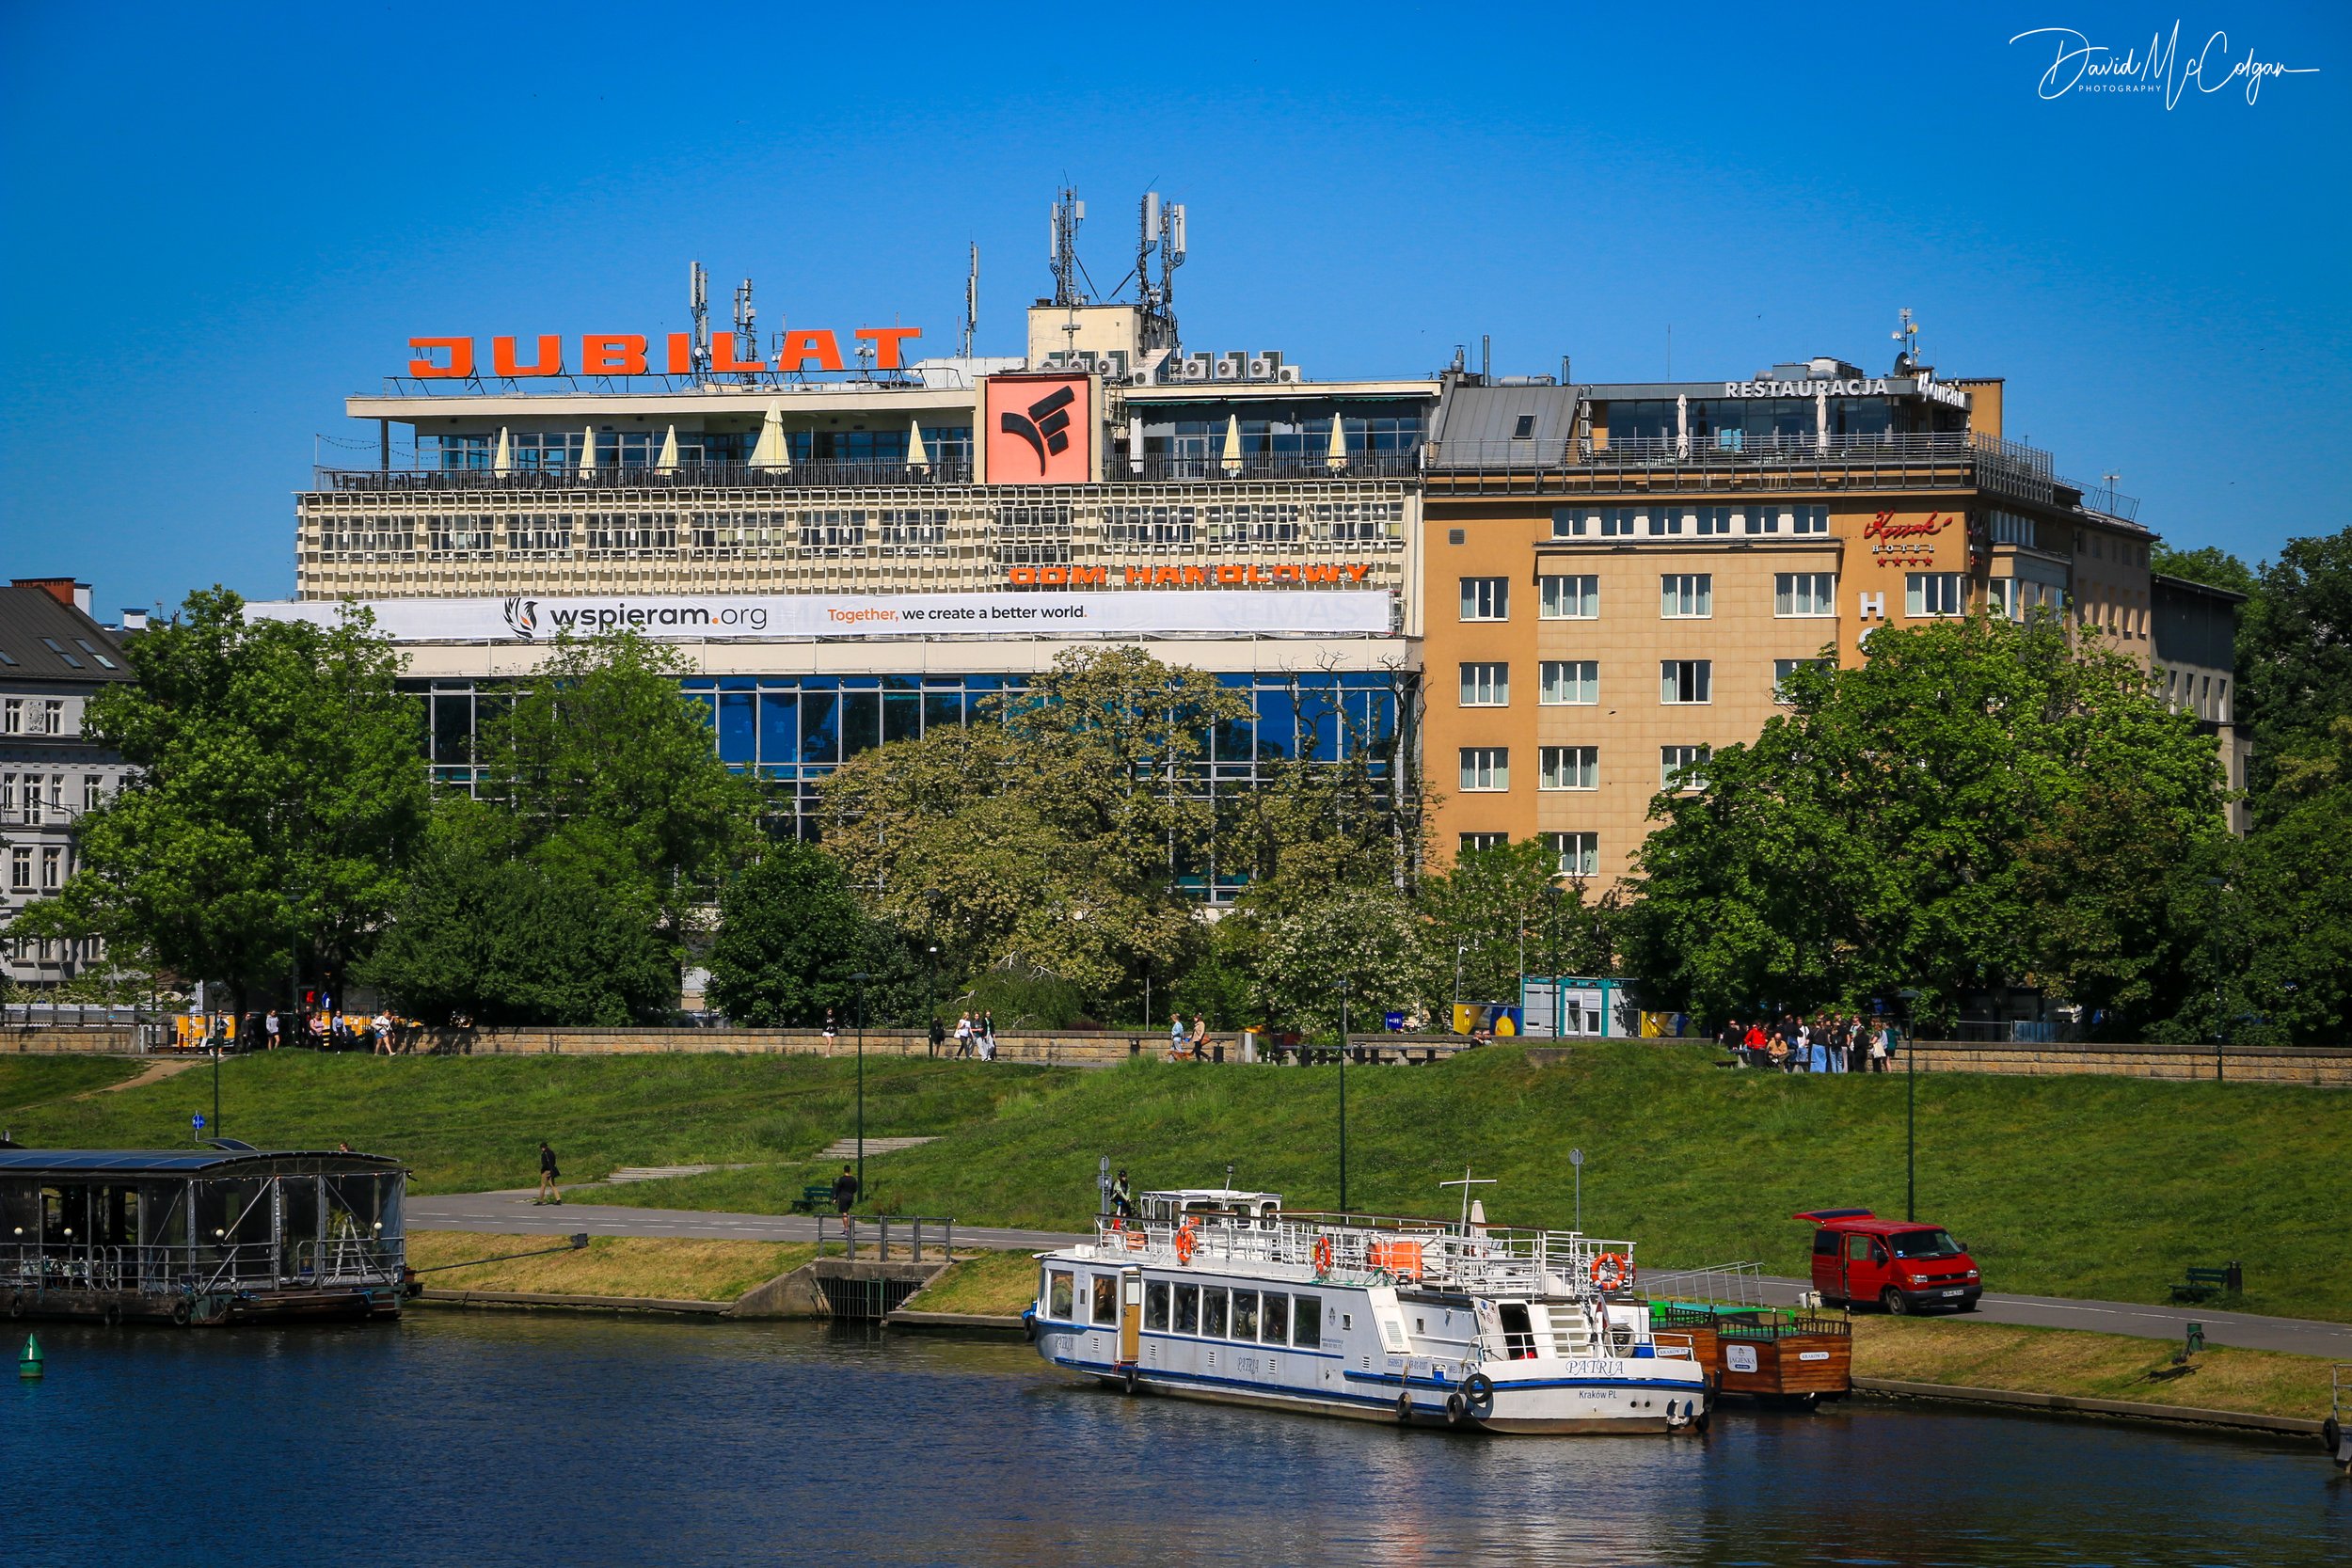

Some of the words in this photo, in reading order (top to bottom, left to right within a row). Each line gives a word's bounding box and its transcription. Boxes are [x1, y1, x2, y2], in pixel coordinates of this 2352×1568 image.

[408, 326, 923, 378] JUBILAT
[1725, 379, 1889, 398] RESTAURACJA
[1872, 544, 1935, 553] HOTEL
[1009, 566, 1106, 585] DOM
[1124, 564, 1370, 585] HANDLOWY
[550, 602, 768, 630] wspieram.org
[828, 608, 898, 624] Together,
[902, 610, 925, 621] we
[928, 608, 976, 620] create
[978, 610, 988, 620] a
[992, 606, 1037, 620] better
[1041, 605, 1088, 619] world.
[1565, 1359, 1626, 1376] PATRIA
[1608, 1390, 1618, 1400] PL
